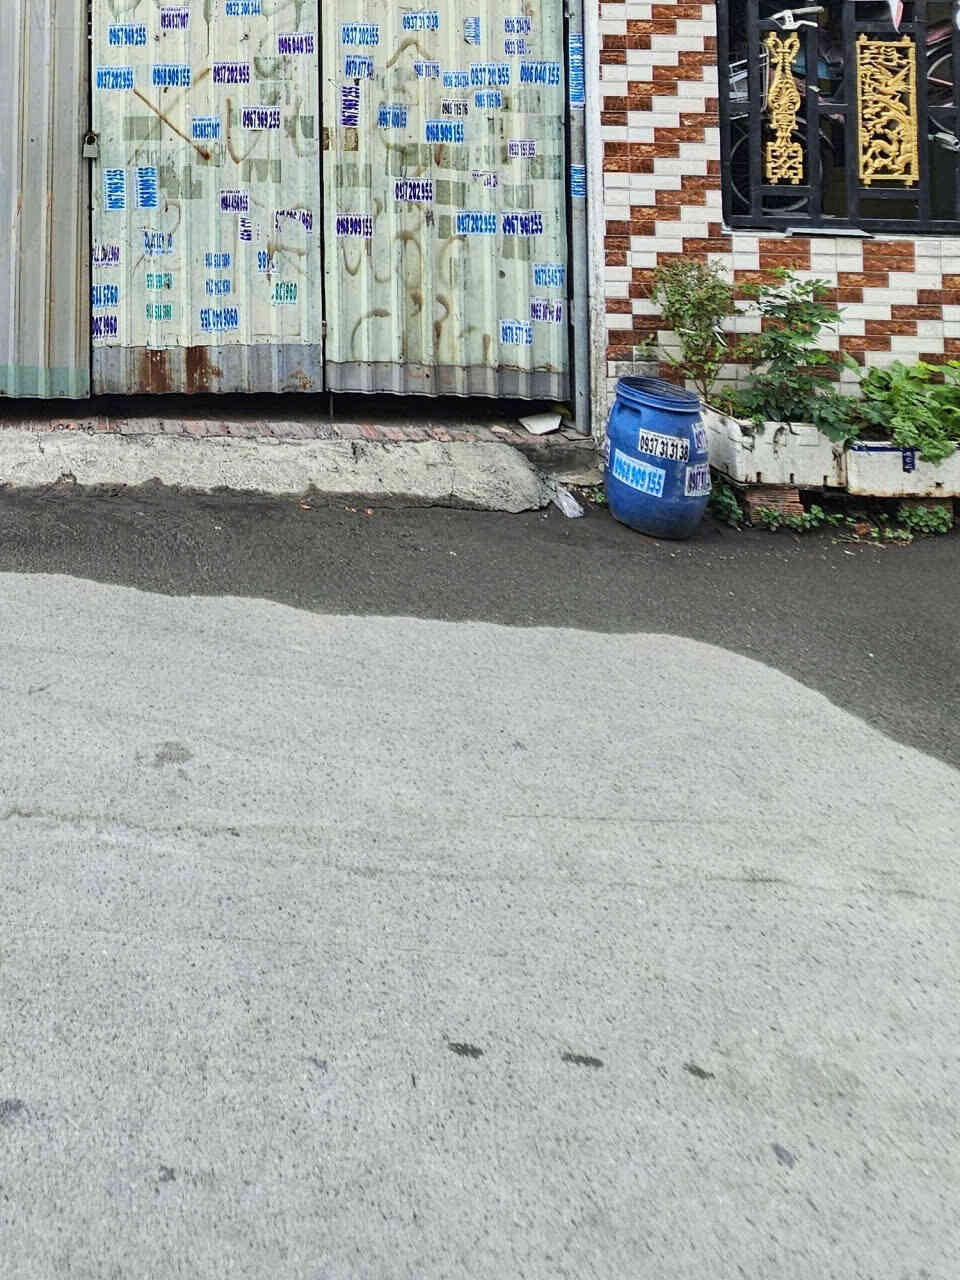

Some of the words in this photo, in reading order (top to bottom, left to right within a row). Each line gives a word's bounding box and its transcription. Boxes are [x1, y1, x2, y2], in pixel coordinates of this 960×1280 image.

[640, 435, 658, 456] 0937
[660, 439, 669, 458] 31
[669, 441, 678, 460] 31
[679, 443, 688, 461] 38
